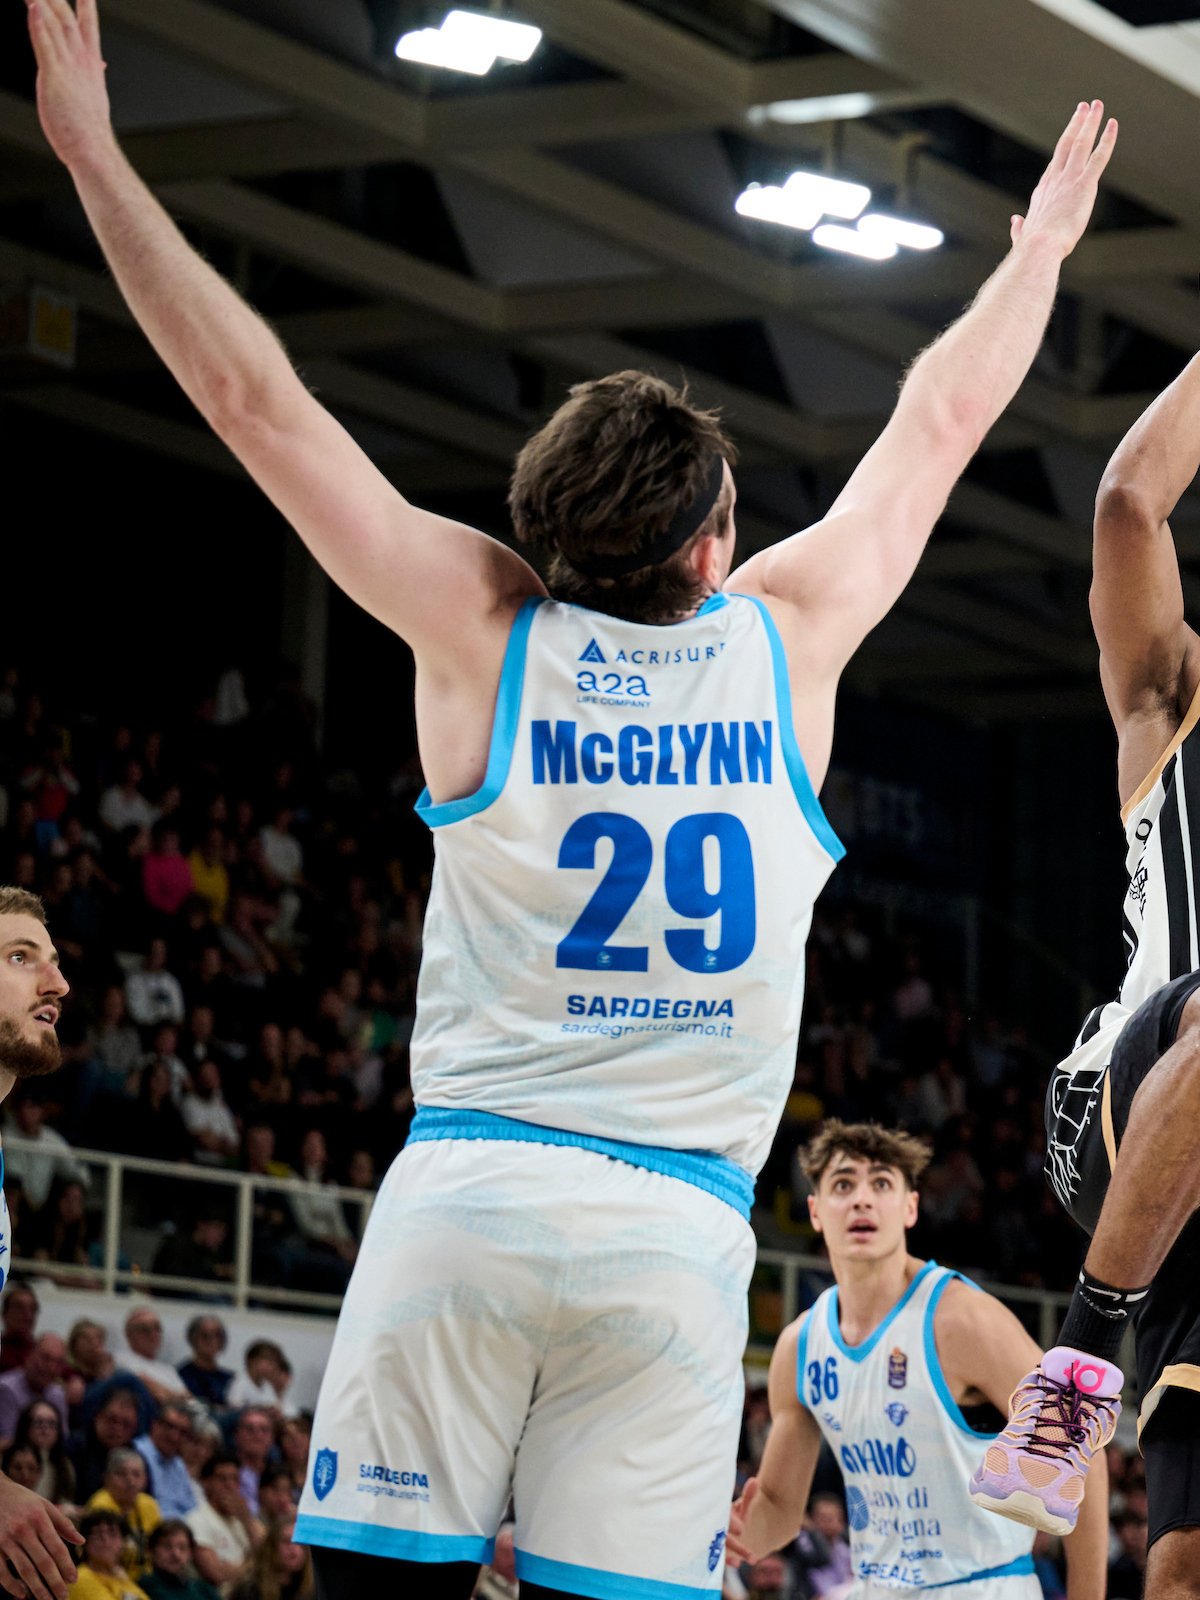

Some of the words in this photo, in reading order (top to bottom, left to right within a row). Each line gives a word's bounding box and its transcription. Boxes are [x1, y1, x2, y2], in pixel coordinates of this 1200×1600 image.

[577, 671, 650, 697] a2a
[577, 695, 601, 704] LIFE
[601, 697, 652, 708] COMPANY
[531, 720, 772, 785] McGLYNN
[556, 811, 756, 974] 29
[567, 995, 734, 1019] SARDEGNA
[807, 1356, 839, 1406] 36
[907, 1486, 929, 1509] di
